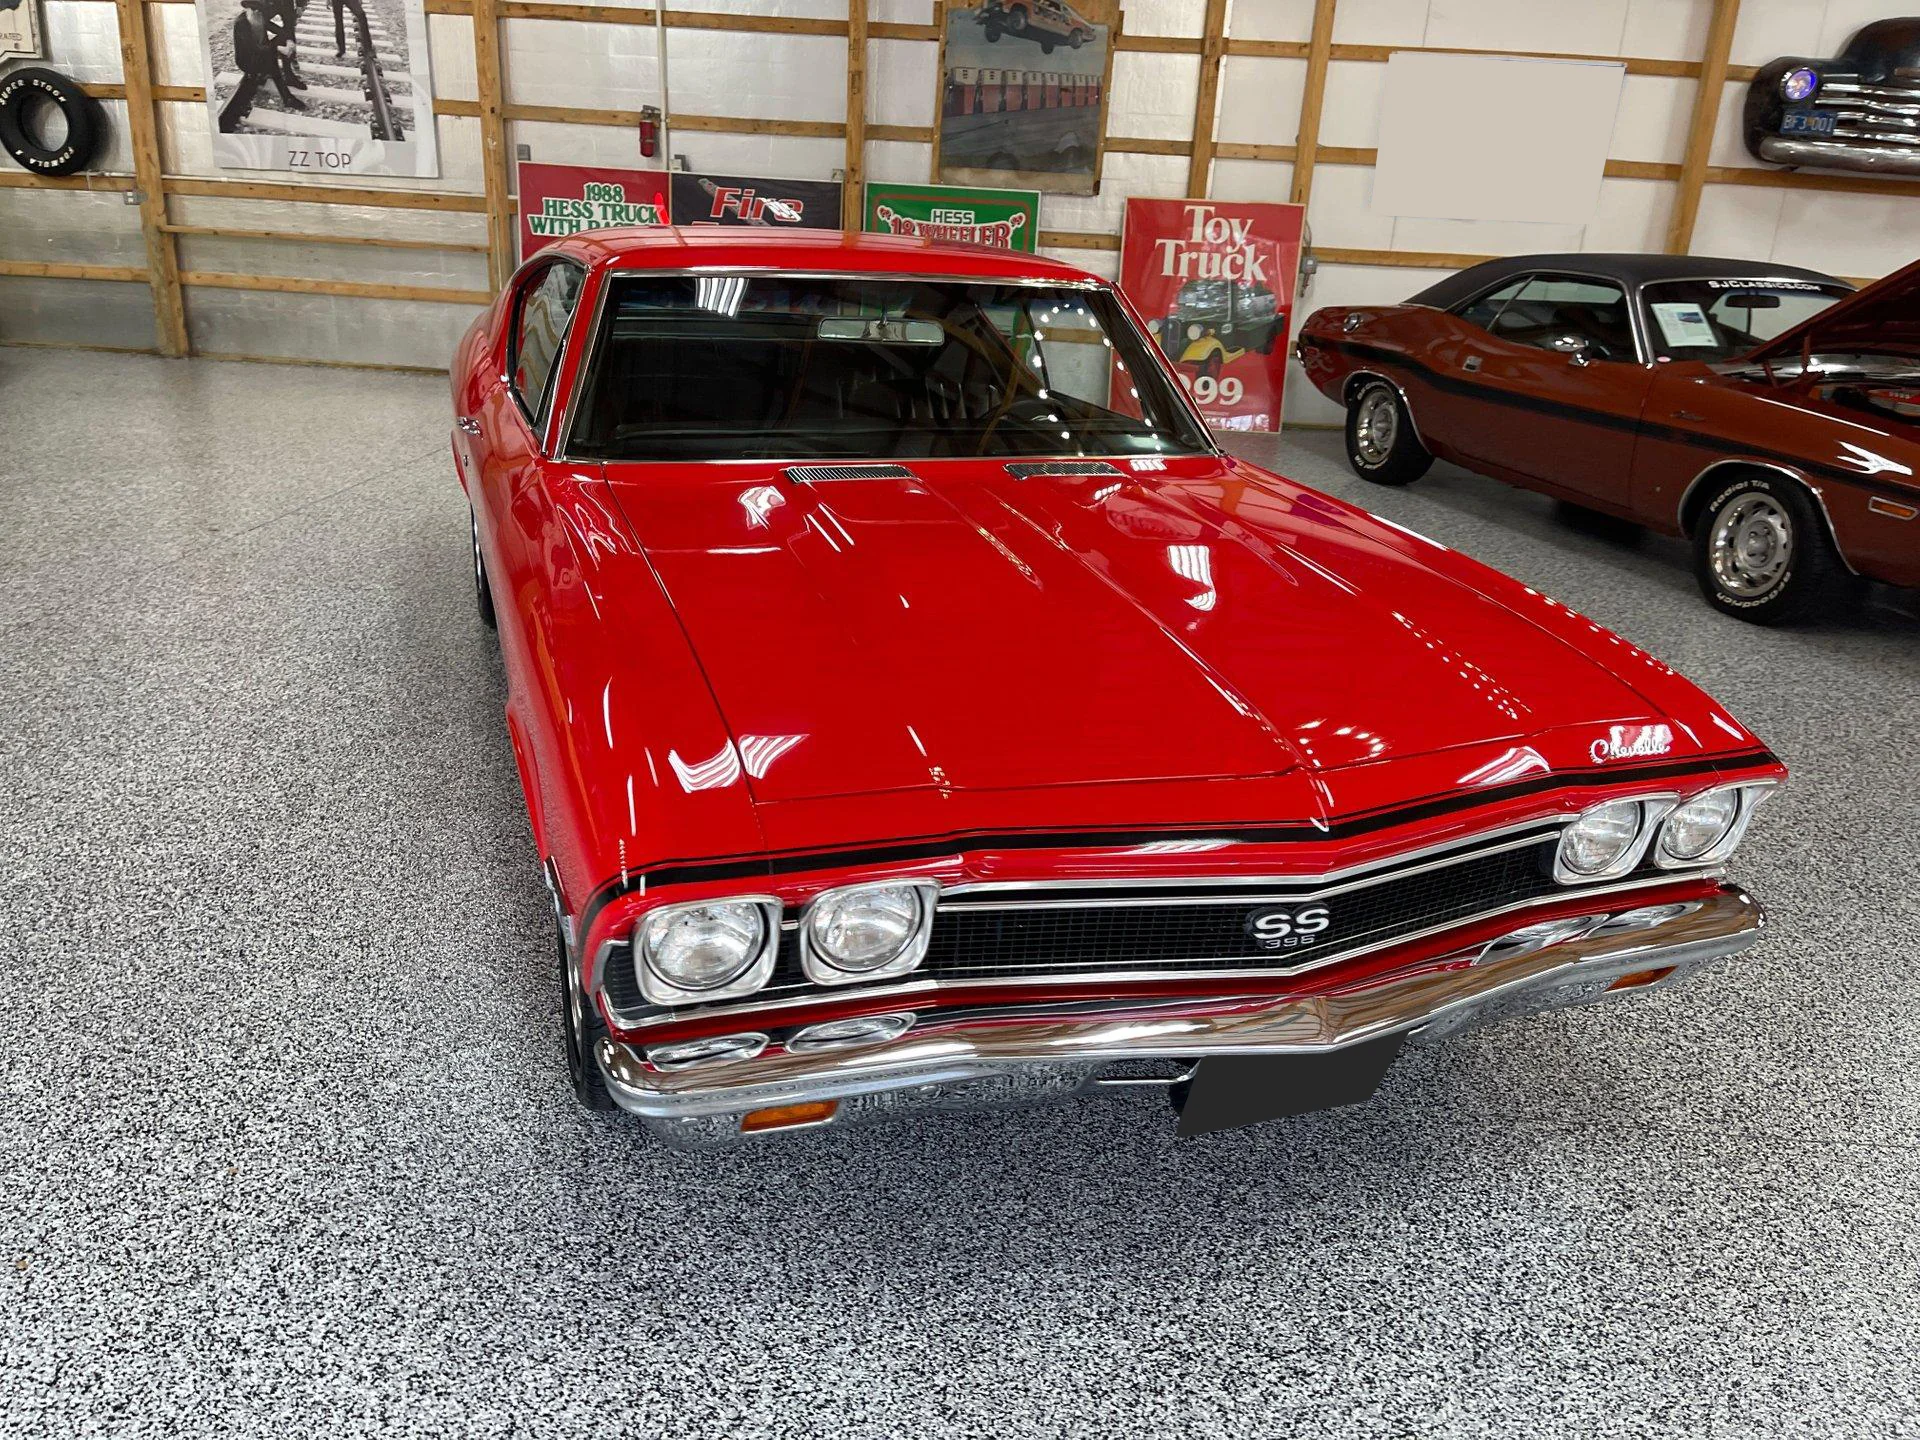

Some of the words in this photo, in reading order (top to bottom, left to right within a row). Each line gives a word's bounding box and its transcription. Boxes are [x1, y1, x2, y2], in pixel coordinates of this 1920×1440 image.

[288, 150, 311, 167] ZZ
[315, 151, 352, 169] TOP
[585, 183, 624, 203] 1988
[710, 187, 804, 222] Fire
[543, 199, 594, 219] HESS
[932, 210, 973, 225] HESS
[529, 215, 581, 236] WITH
[1184, 205, 1254, 253] Toy
[1155, 238, 1268, 281] Truck
[1709, 481, 1749, 512] Radial
[1751, 479, 1770, 490] T/A
[1253, 908, 1330, 940] SS
